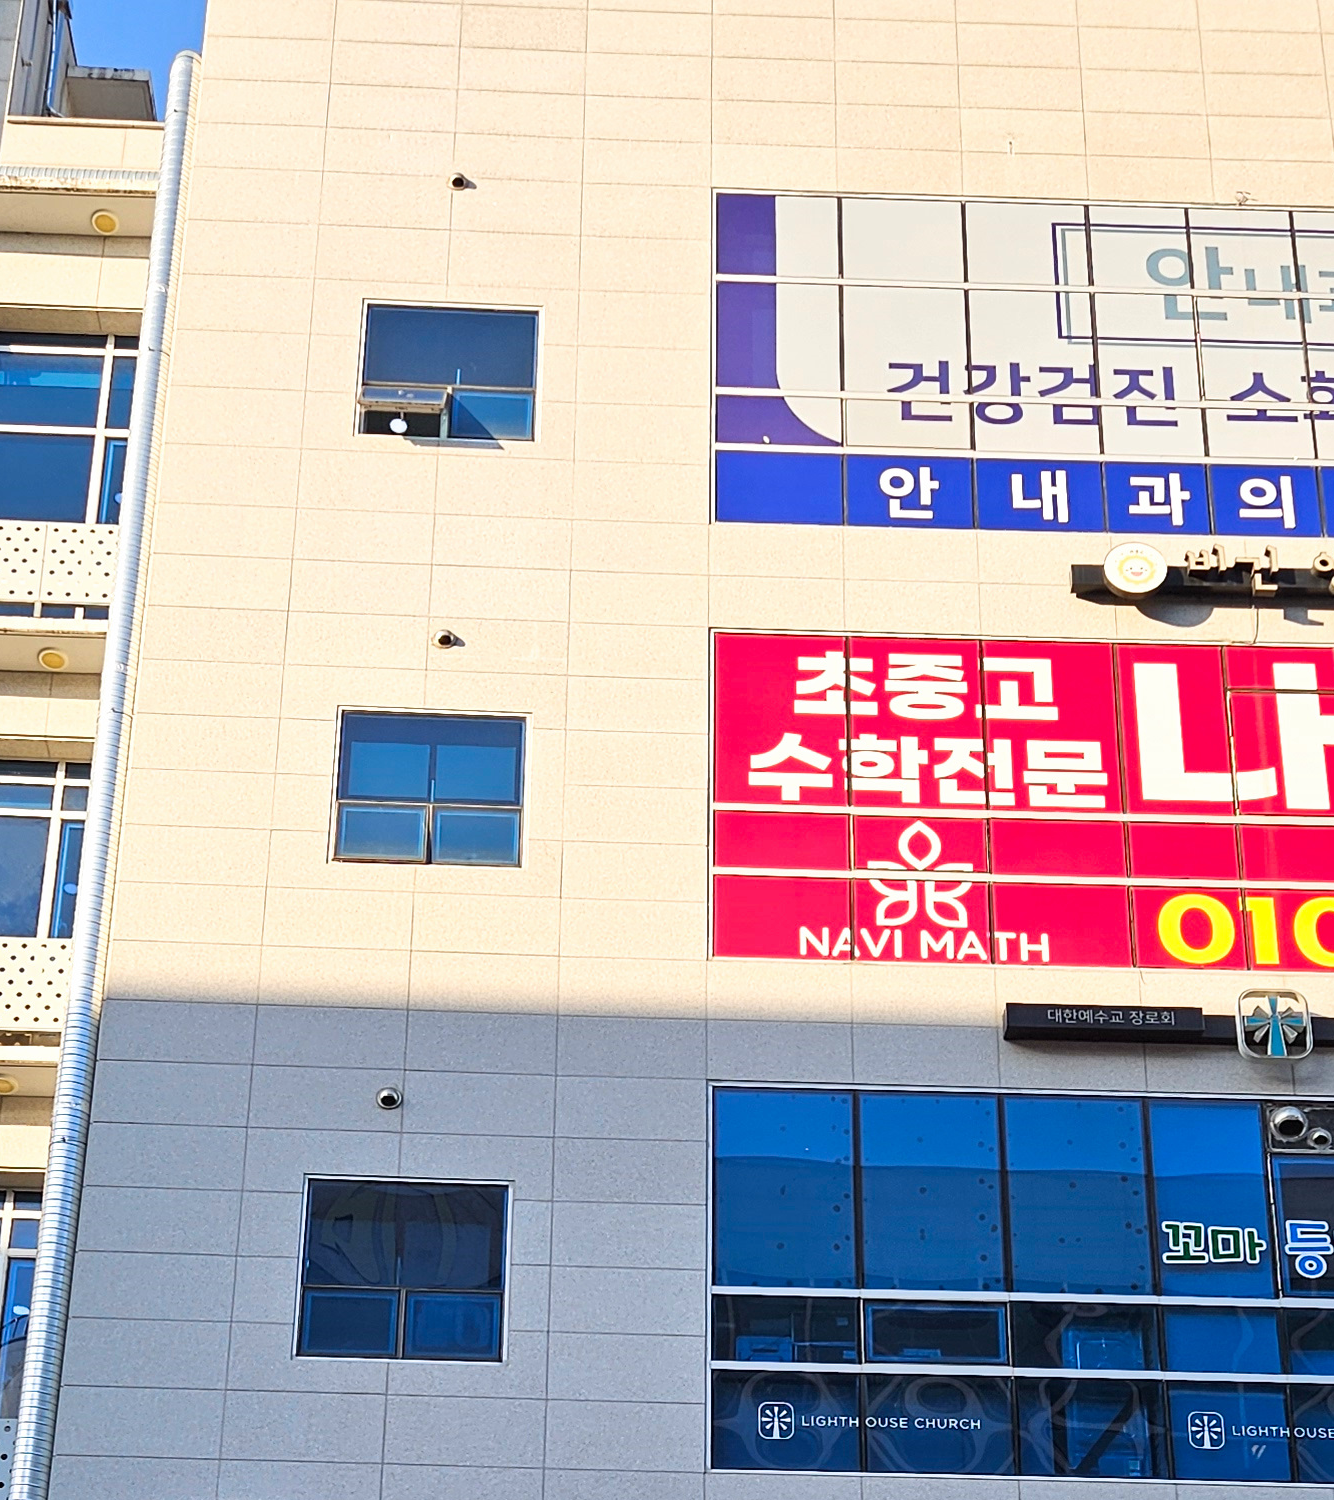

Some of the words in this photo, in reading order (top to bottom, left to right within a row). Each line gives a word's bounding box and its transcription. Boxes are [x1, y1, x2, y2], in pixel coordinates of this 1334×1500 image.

[887, 360, 1179, 427] 건강검진
[793, 650, 1060, 722] 초중고
[747, 732, 1109, 810] 수학전문
[798, 927, 904, 960] NAVI
[920, 930, 1051, 964] MATH
[1047, 1008, 1125, 1024] 대한예수교
[1128, 1010, 1175, 1026] 장로회
[1163, 1219, 1267, 1265] 꼬마
[913, 1417, 983, 1431] CHURCH
